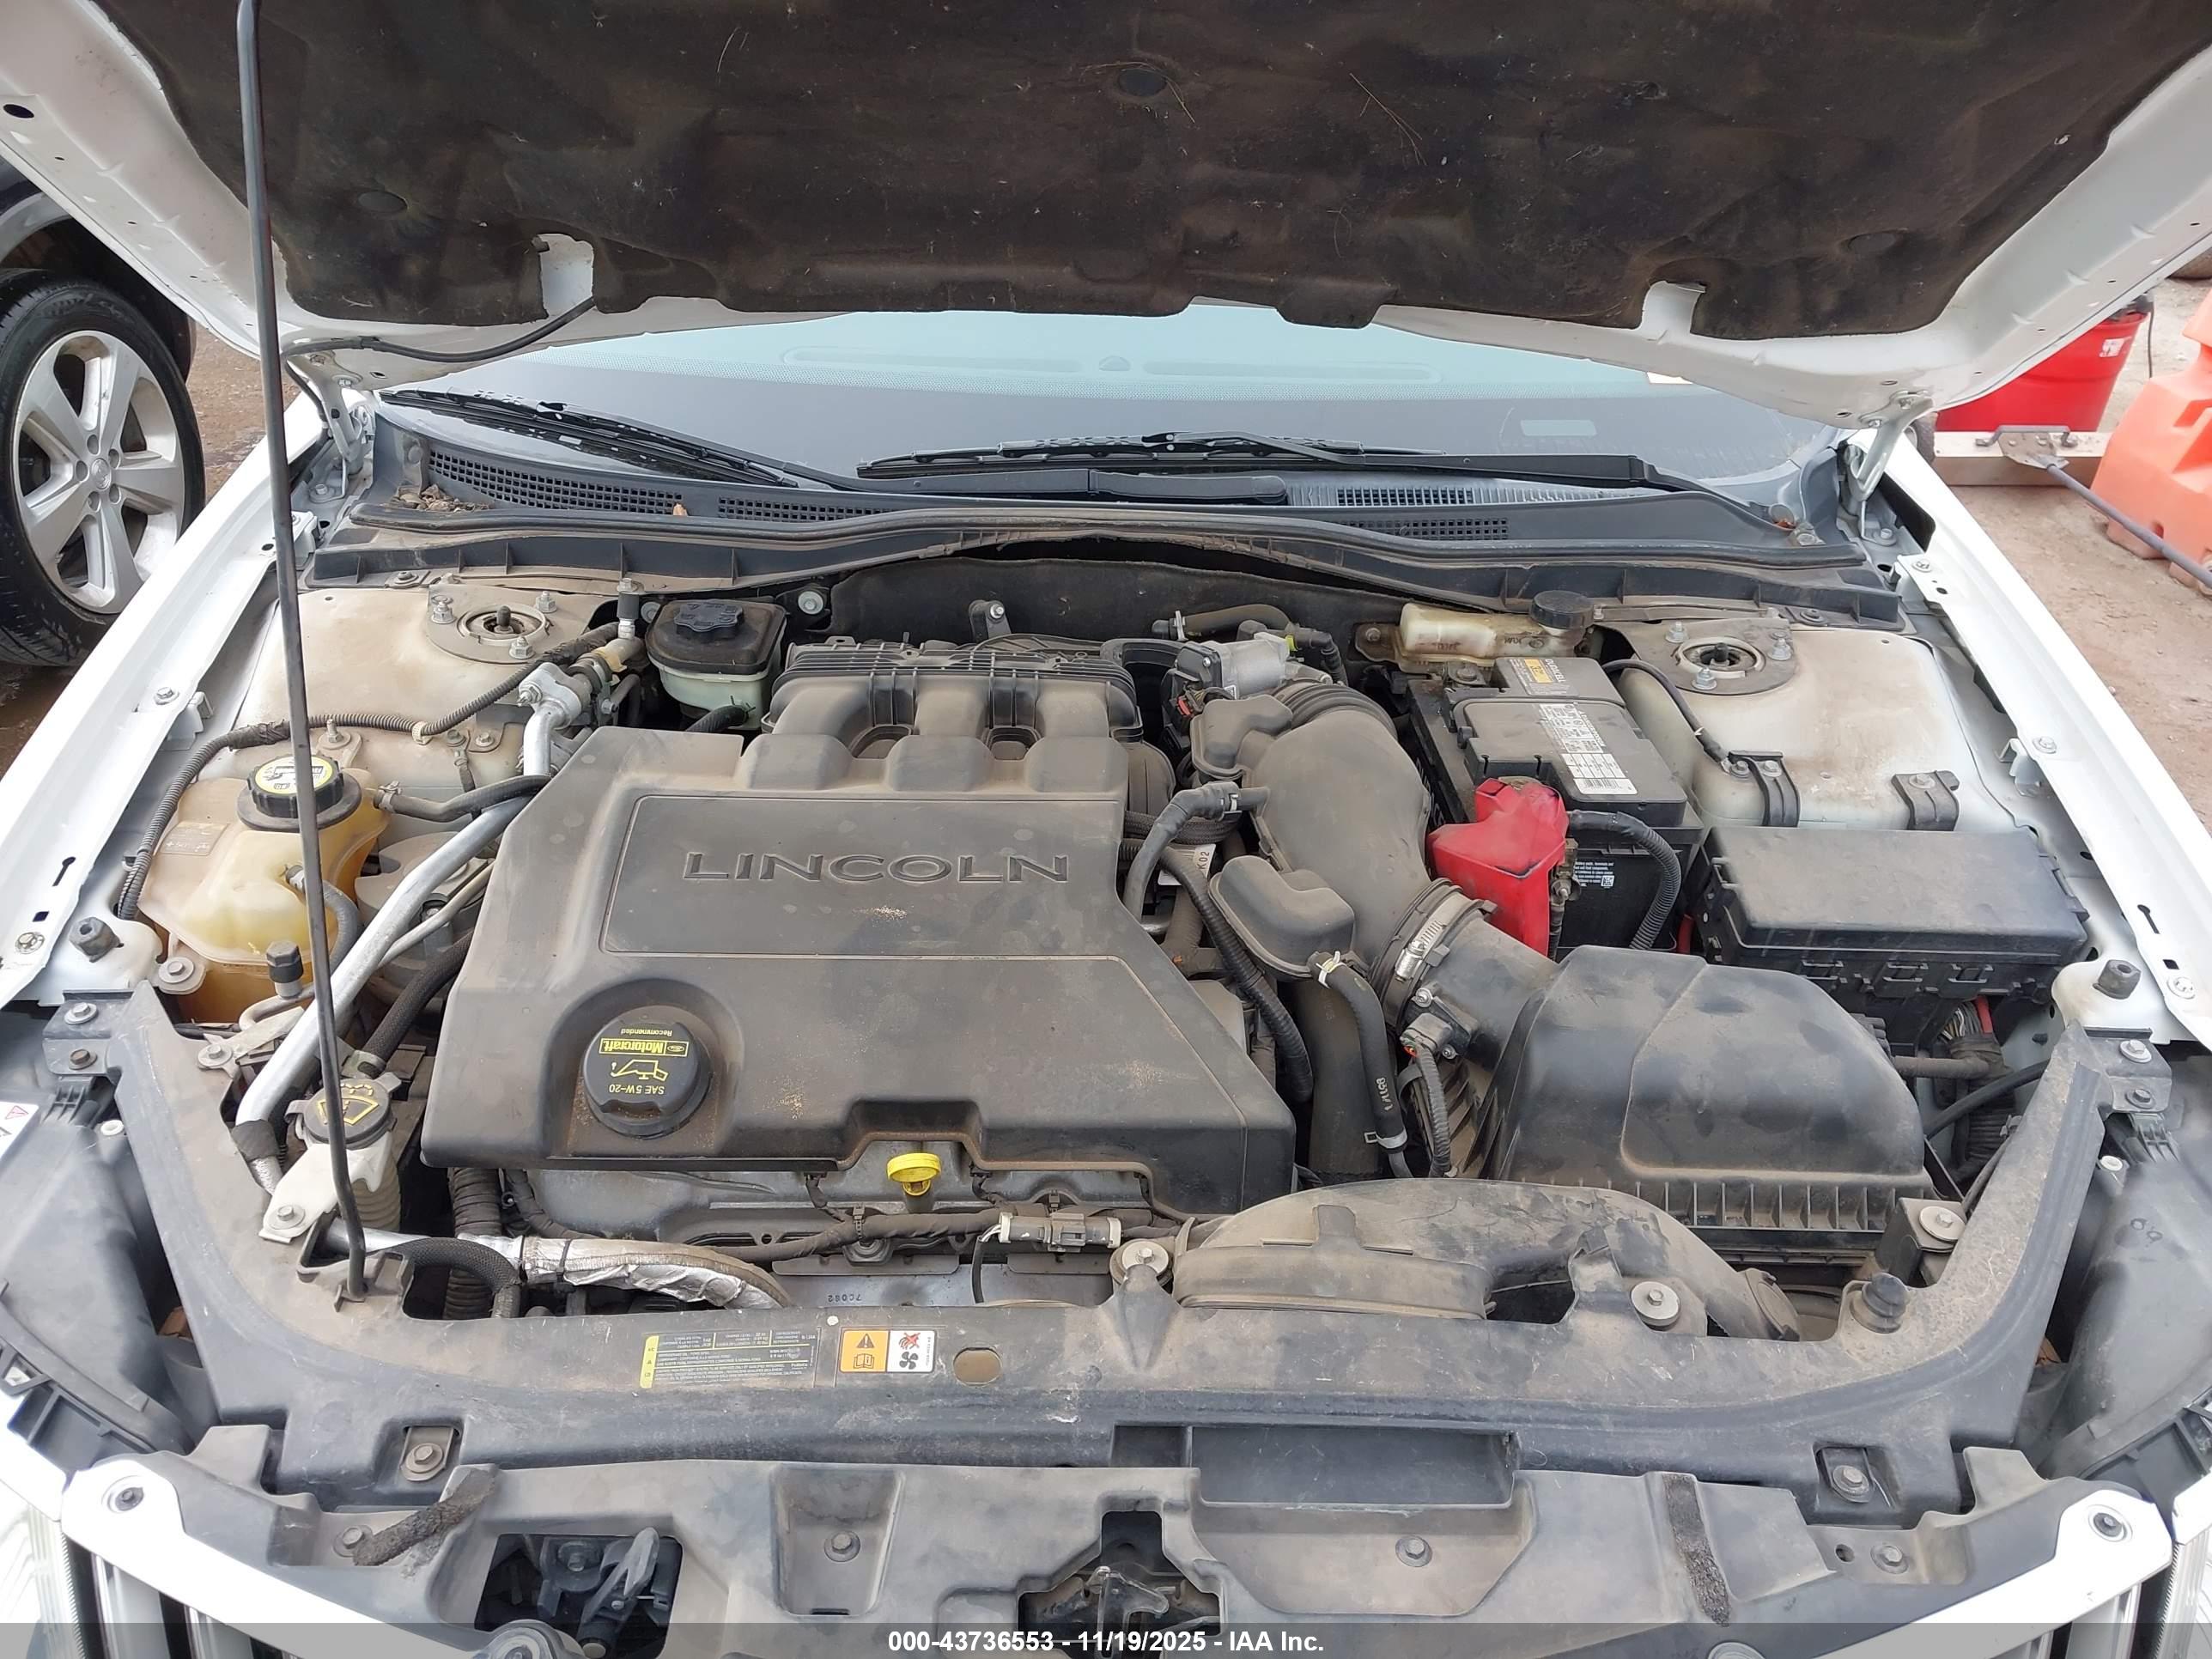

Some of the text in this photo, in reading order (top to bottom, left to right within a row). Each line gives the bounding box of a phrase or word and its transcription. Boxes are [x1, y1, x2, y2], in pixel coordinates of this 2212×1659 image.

[683, 852, 1068, 883] LINCOLN
[603, 1041, 664, 1053] Motorcraft
[645, 1085, 665, 1095] SAE
